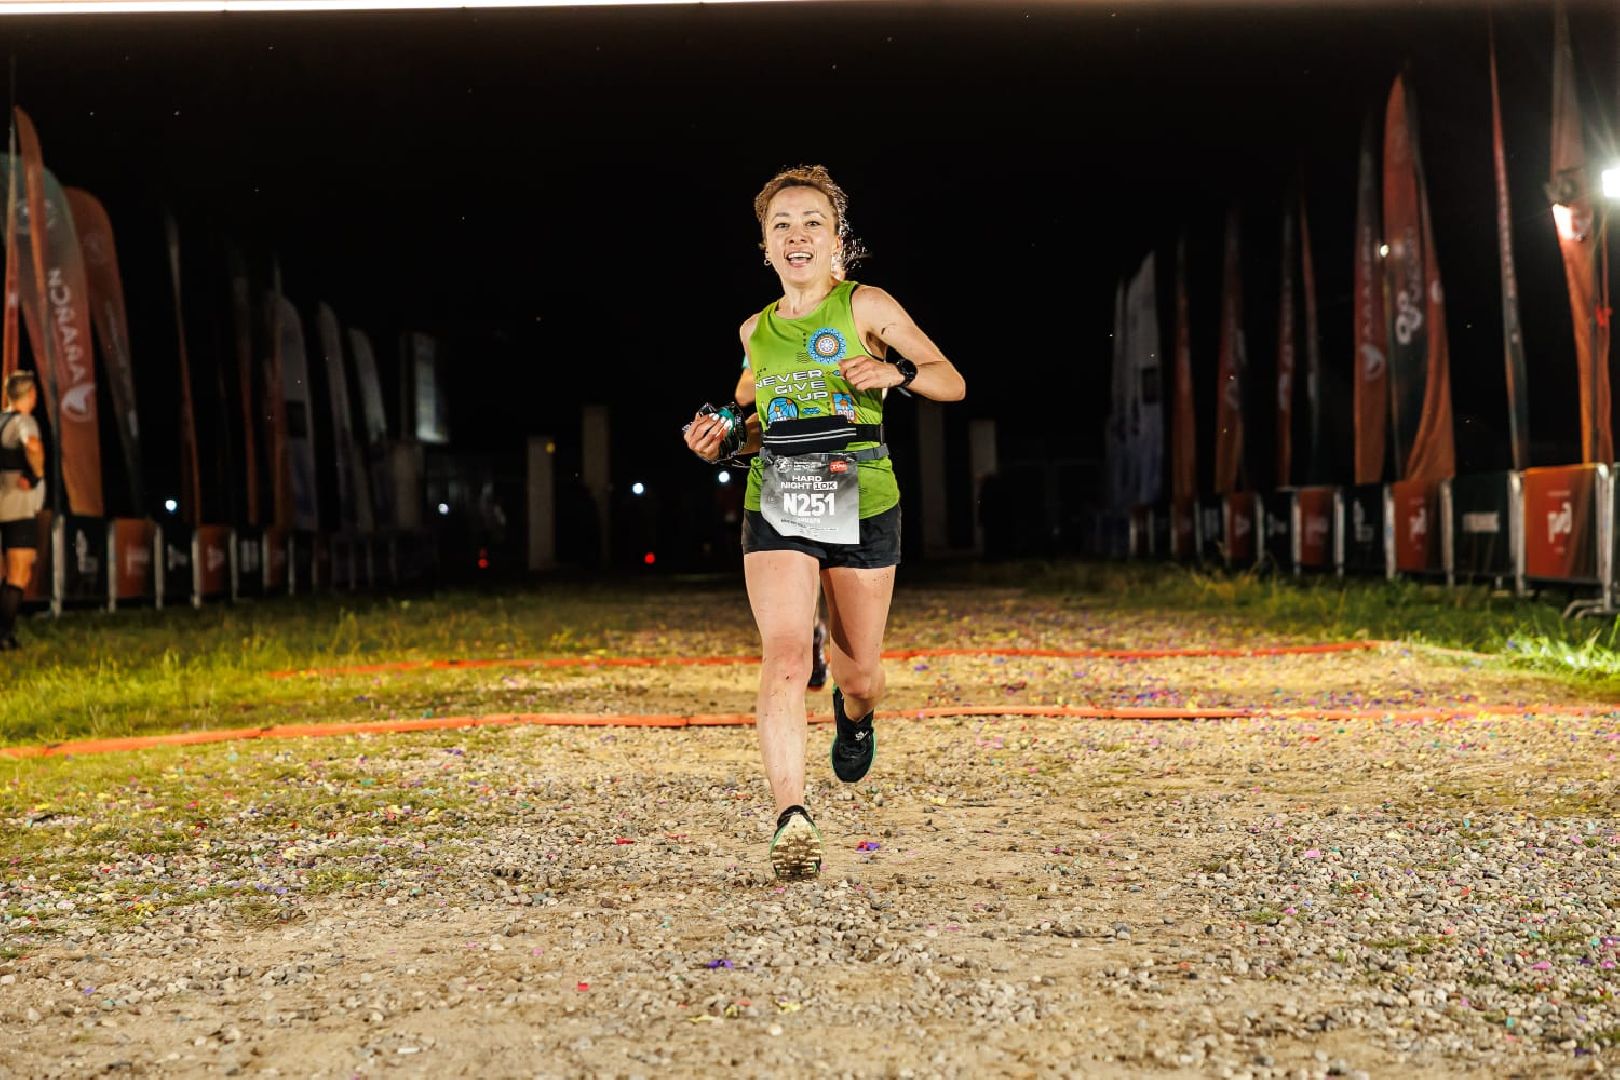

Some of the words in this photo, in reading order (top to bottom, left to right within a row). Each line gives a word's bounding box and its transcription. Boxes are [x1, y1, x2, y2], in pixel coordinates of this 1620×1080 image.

[756, 369, 823, 388] NEVER
[775, 380, 826, 394] GIVE
[798, 391, 828, 401] UP
[781, 482, 812, 490] NIGHT
[814, 482, 837, 490] 10K
[783, 493, 835, 517] N251
